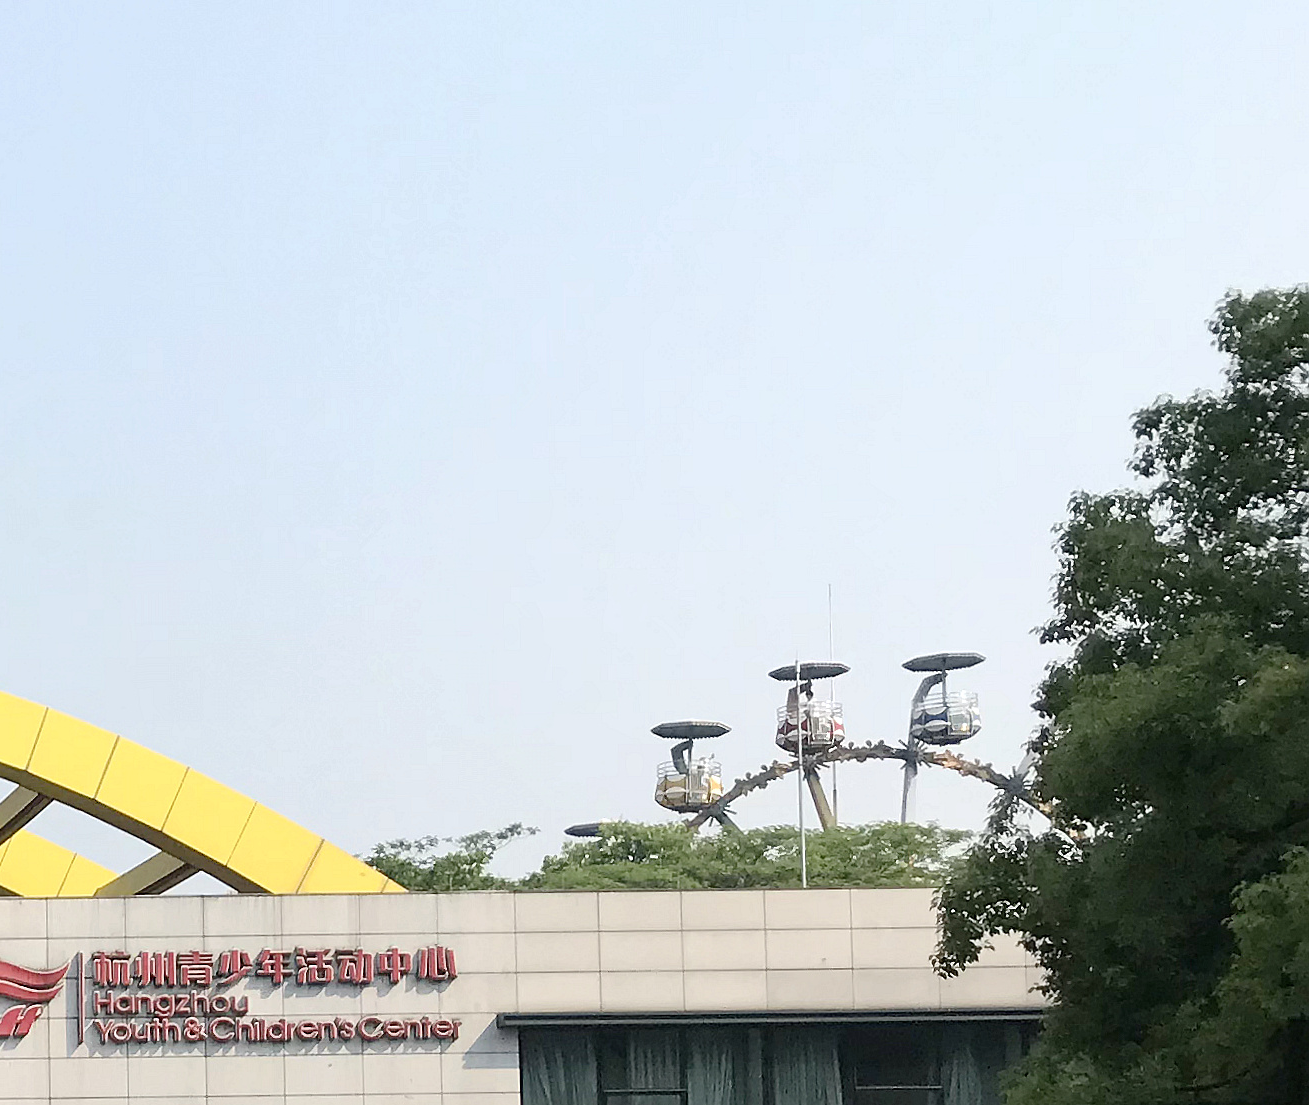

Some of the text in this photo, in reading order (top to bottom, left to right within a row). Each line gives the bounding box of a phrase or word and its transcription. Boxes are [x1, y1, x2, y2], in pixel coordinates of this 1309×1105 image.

[93, 945, 458, 988] 杭州青少年活动中心
[93, 989, 250, 1017] Hangzhou
[92, 1017, 182, 1044] Youth
[209, 1016, 356, 1043] Children's
[357, 1015, 462, 1043] Center
